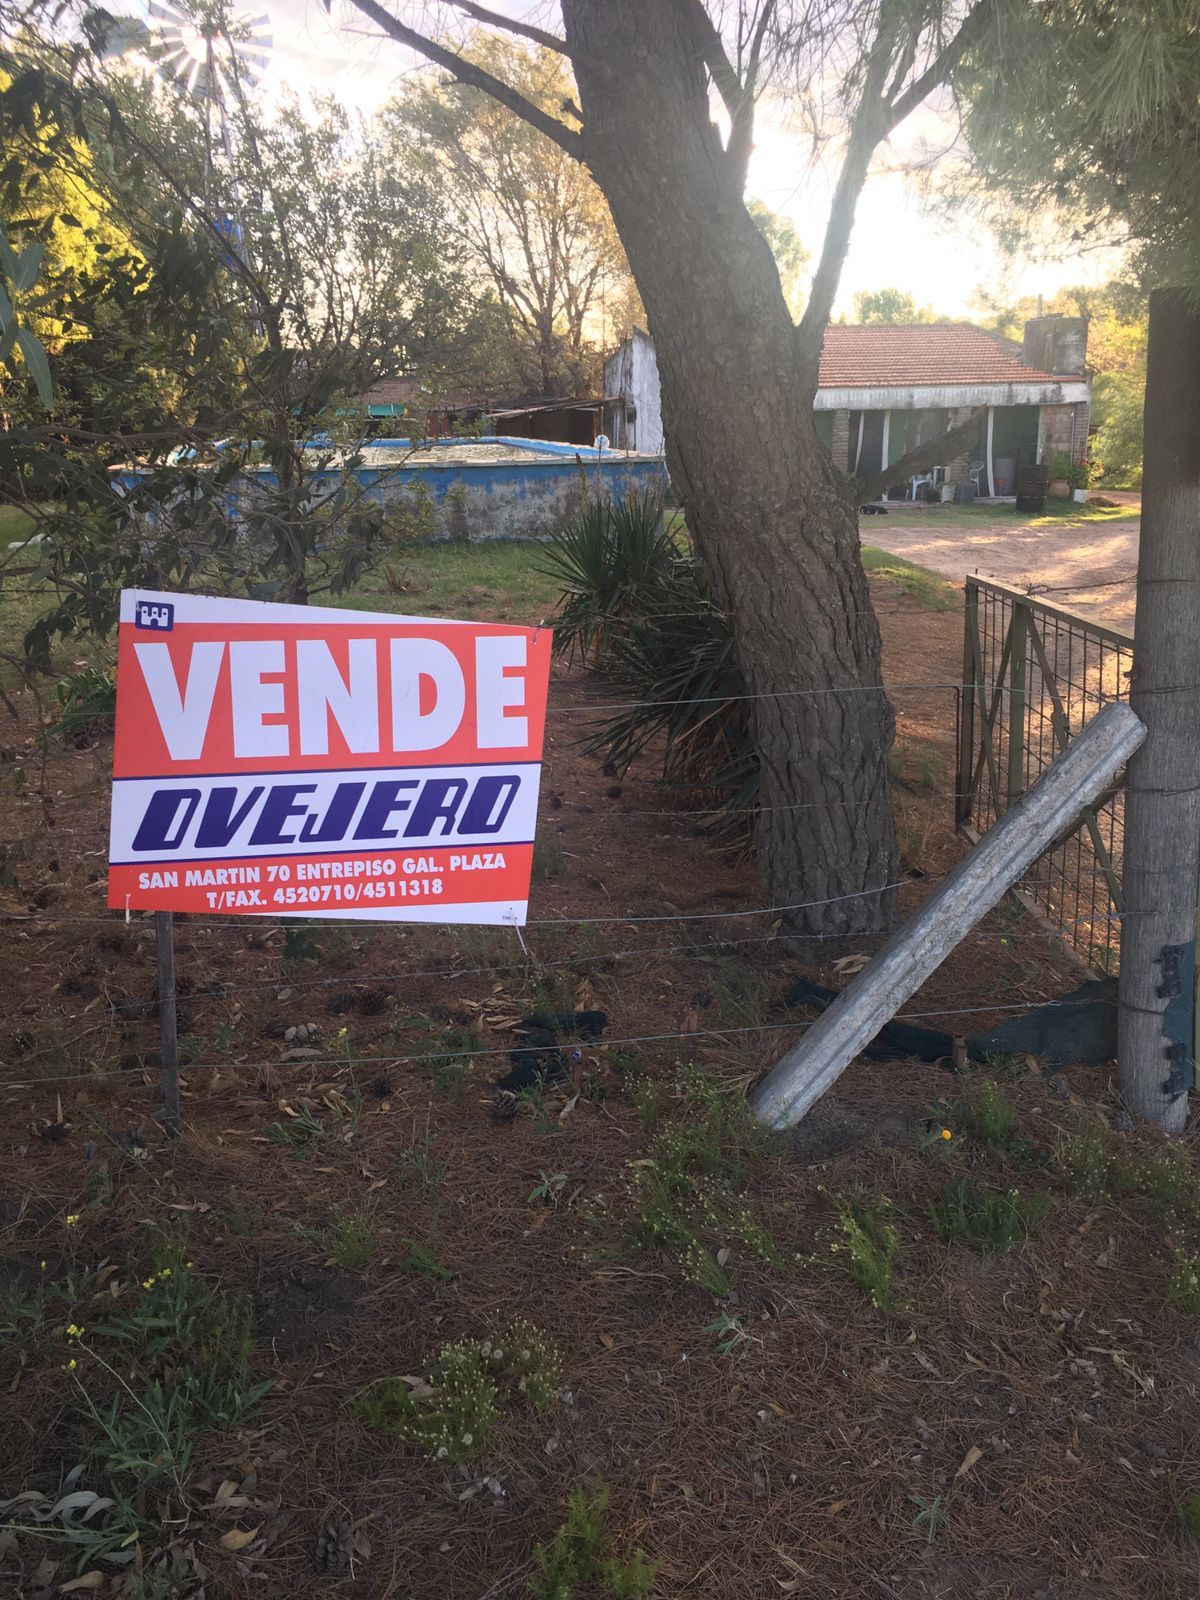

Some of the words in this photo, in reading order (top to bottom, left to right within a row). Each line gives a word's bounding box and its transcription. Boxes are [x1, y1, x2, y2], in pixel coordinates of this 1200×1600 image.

[134, 636, 529, 760] VENDE
[132, 775, 521, 851] OVEJERO
[138, 872, 178, 890] SAN
[185, 867, 261, 888] MARTIN
[267, 865, 291, 883] 70
[297, 859, 396, 881] ENTREPISO
[402, 856, 445, 875] GAL.
[450, 853, 507, 872] PLAZA
[206, 890, 267, 910] T/FAX.
[272, 878, 443, 905] 4520710/4511318
